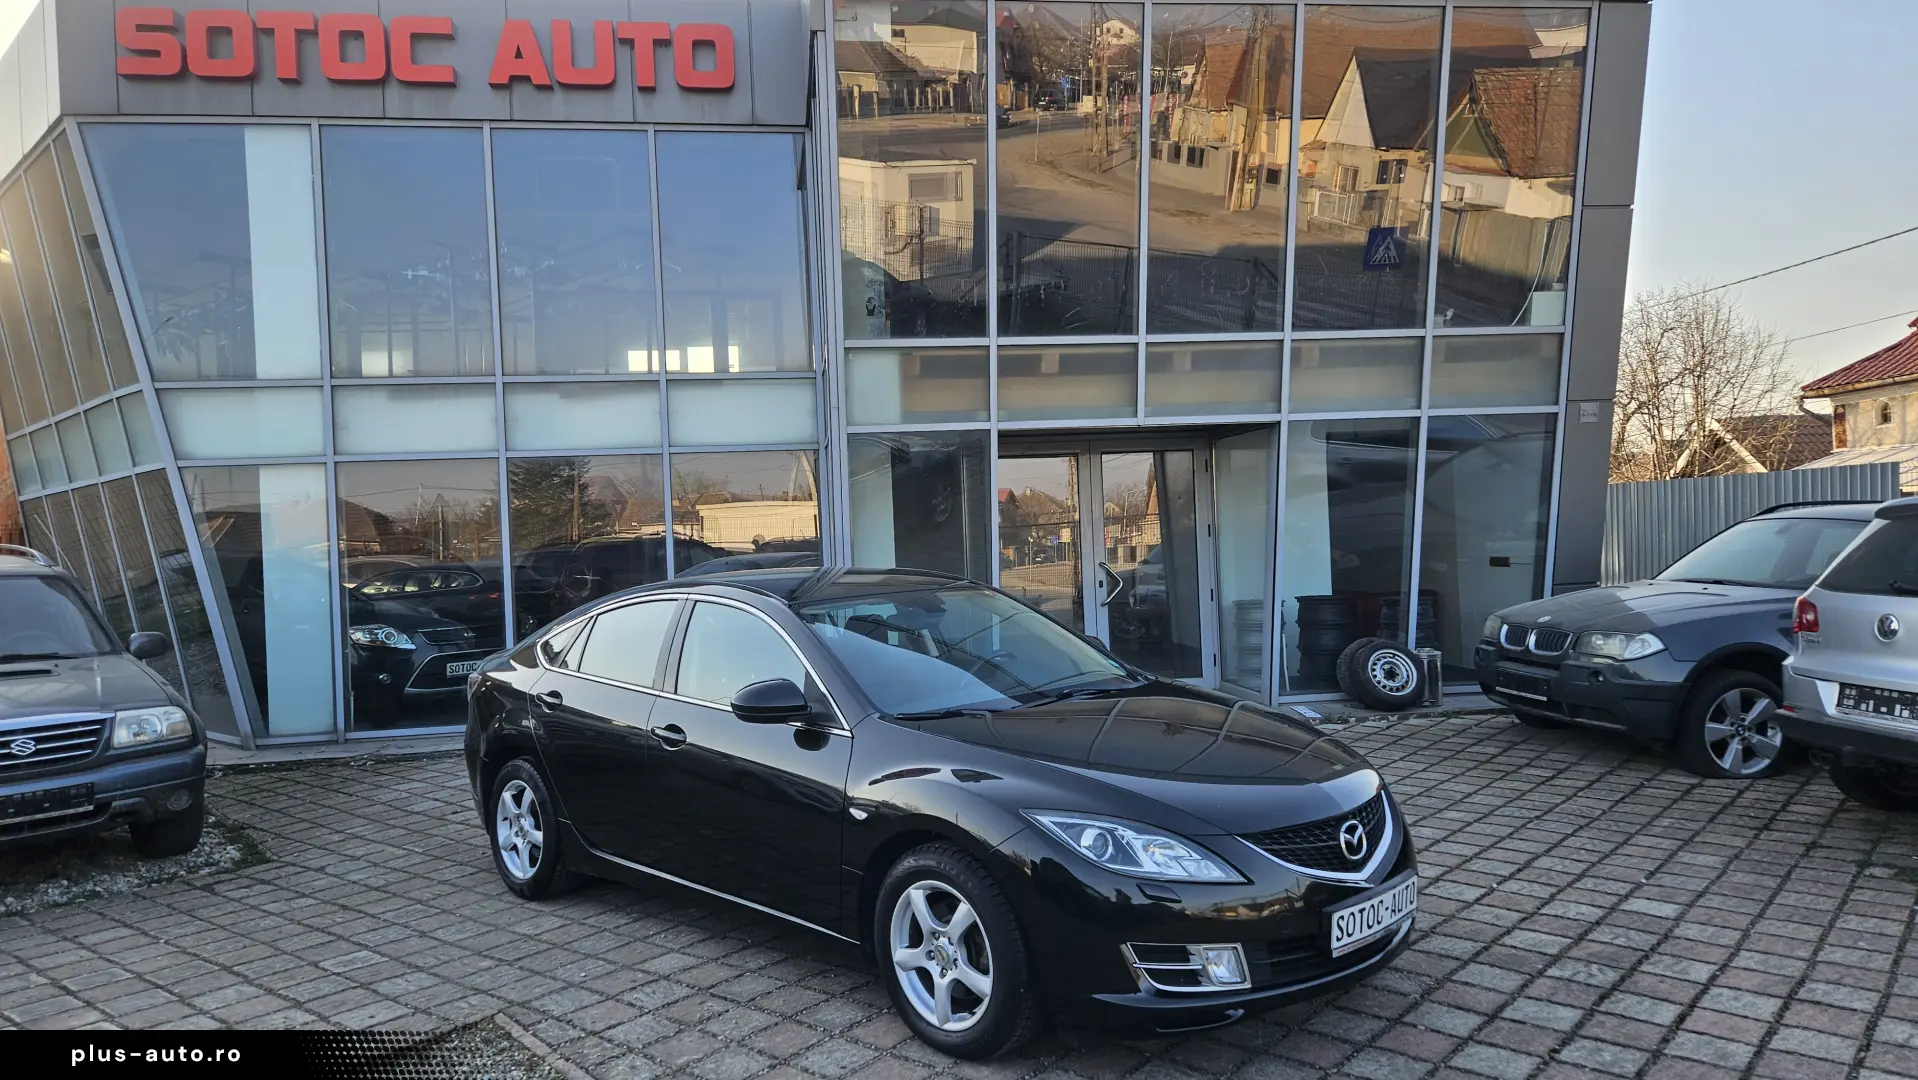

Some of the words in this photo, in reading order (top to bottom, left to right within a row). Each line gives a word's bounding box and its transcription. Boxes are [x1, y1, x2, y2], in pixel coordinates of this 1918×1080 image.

[115, 6, 456, 87] SOTOC
[488, 18, 735, 92] AUTO
[1336, 880, 1416, 943] SOTOC-AUTO
